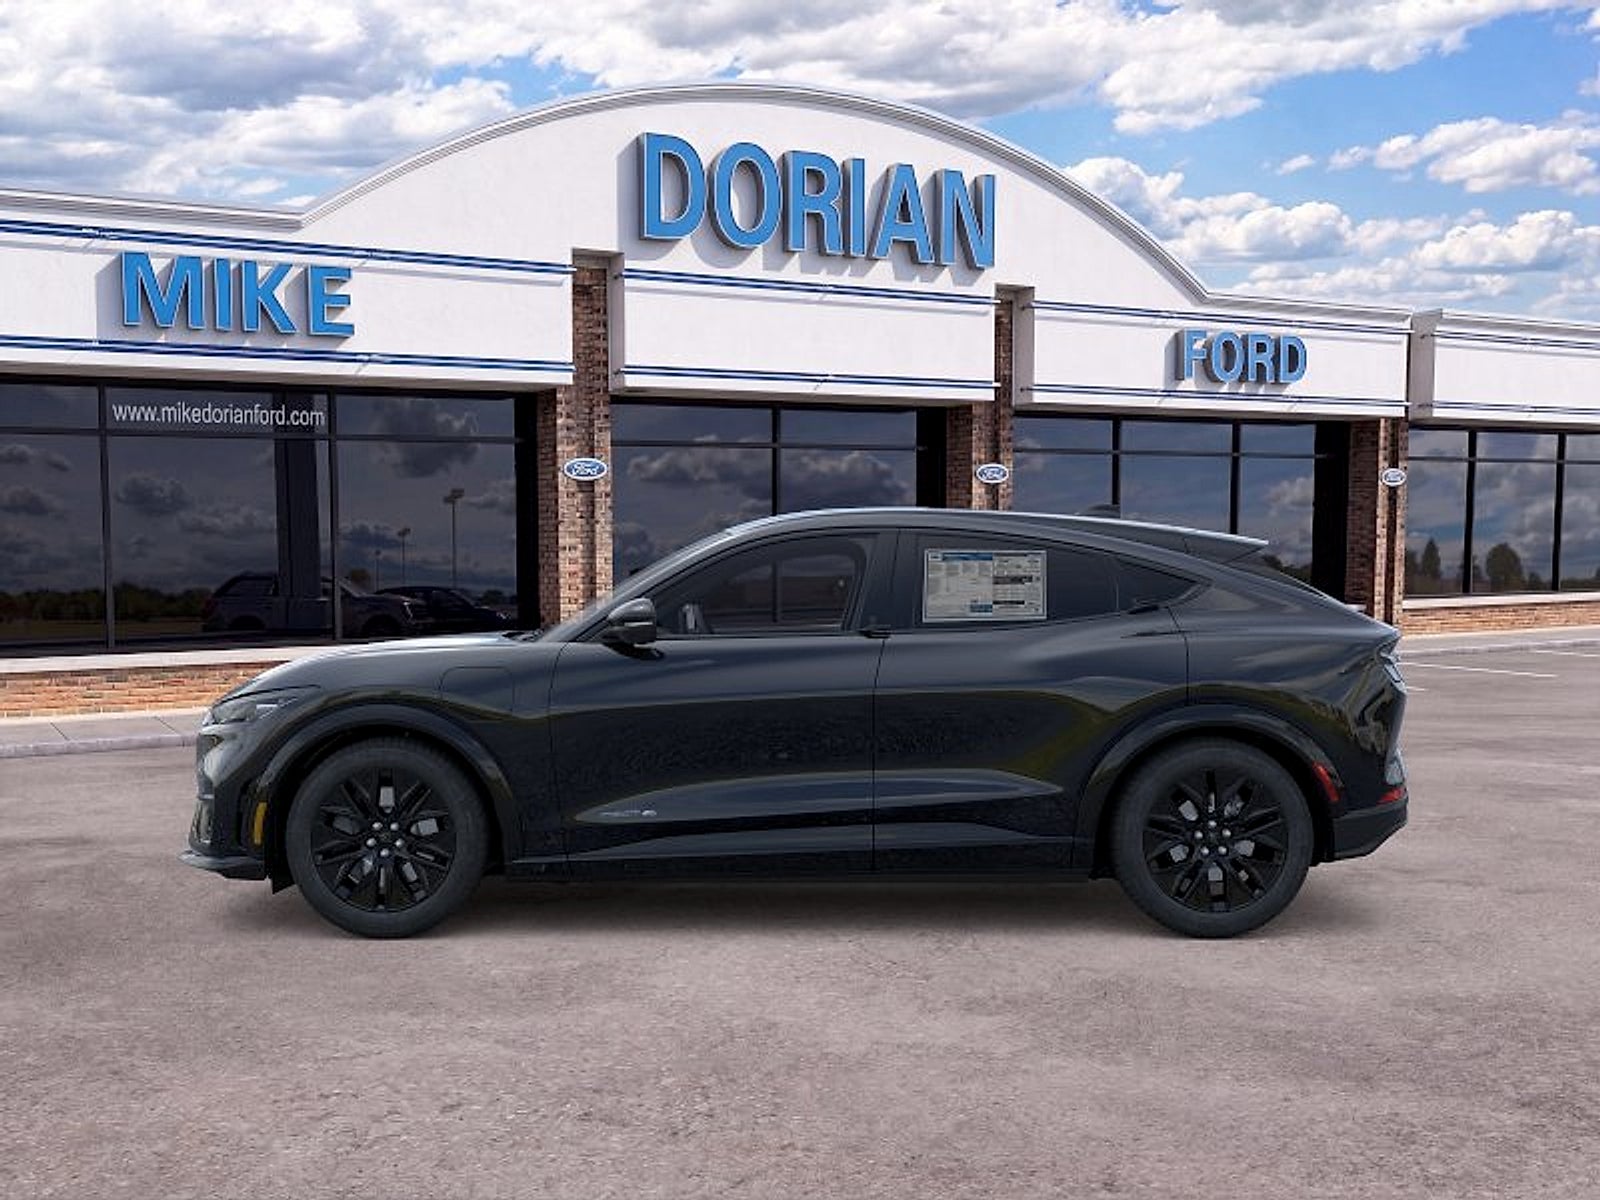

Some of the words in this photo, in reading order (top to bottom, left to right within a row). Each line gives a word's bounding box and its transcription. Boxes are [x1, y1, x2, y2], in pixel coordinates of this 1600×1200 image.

[638, 132, 996, 268] DORIAN
[120, 250, 356, 338] MIKE
[1177, 327, 1307, 384] FORD
[111, 402, 326, 426] www.mikedorianford.com
